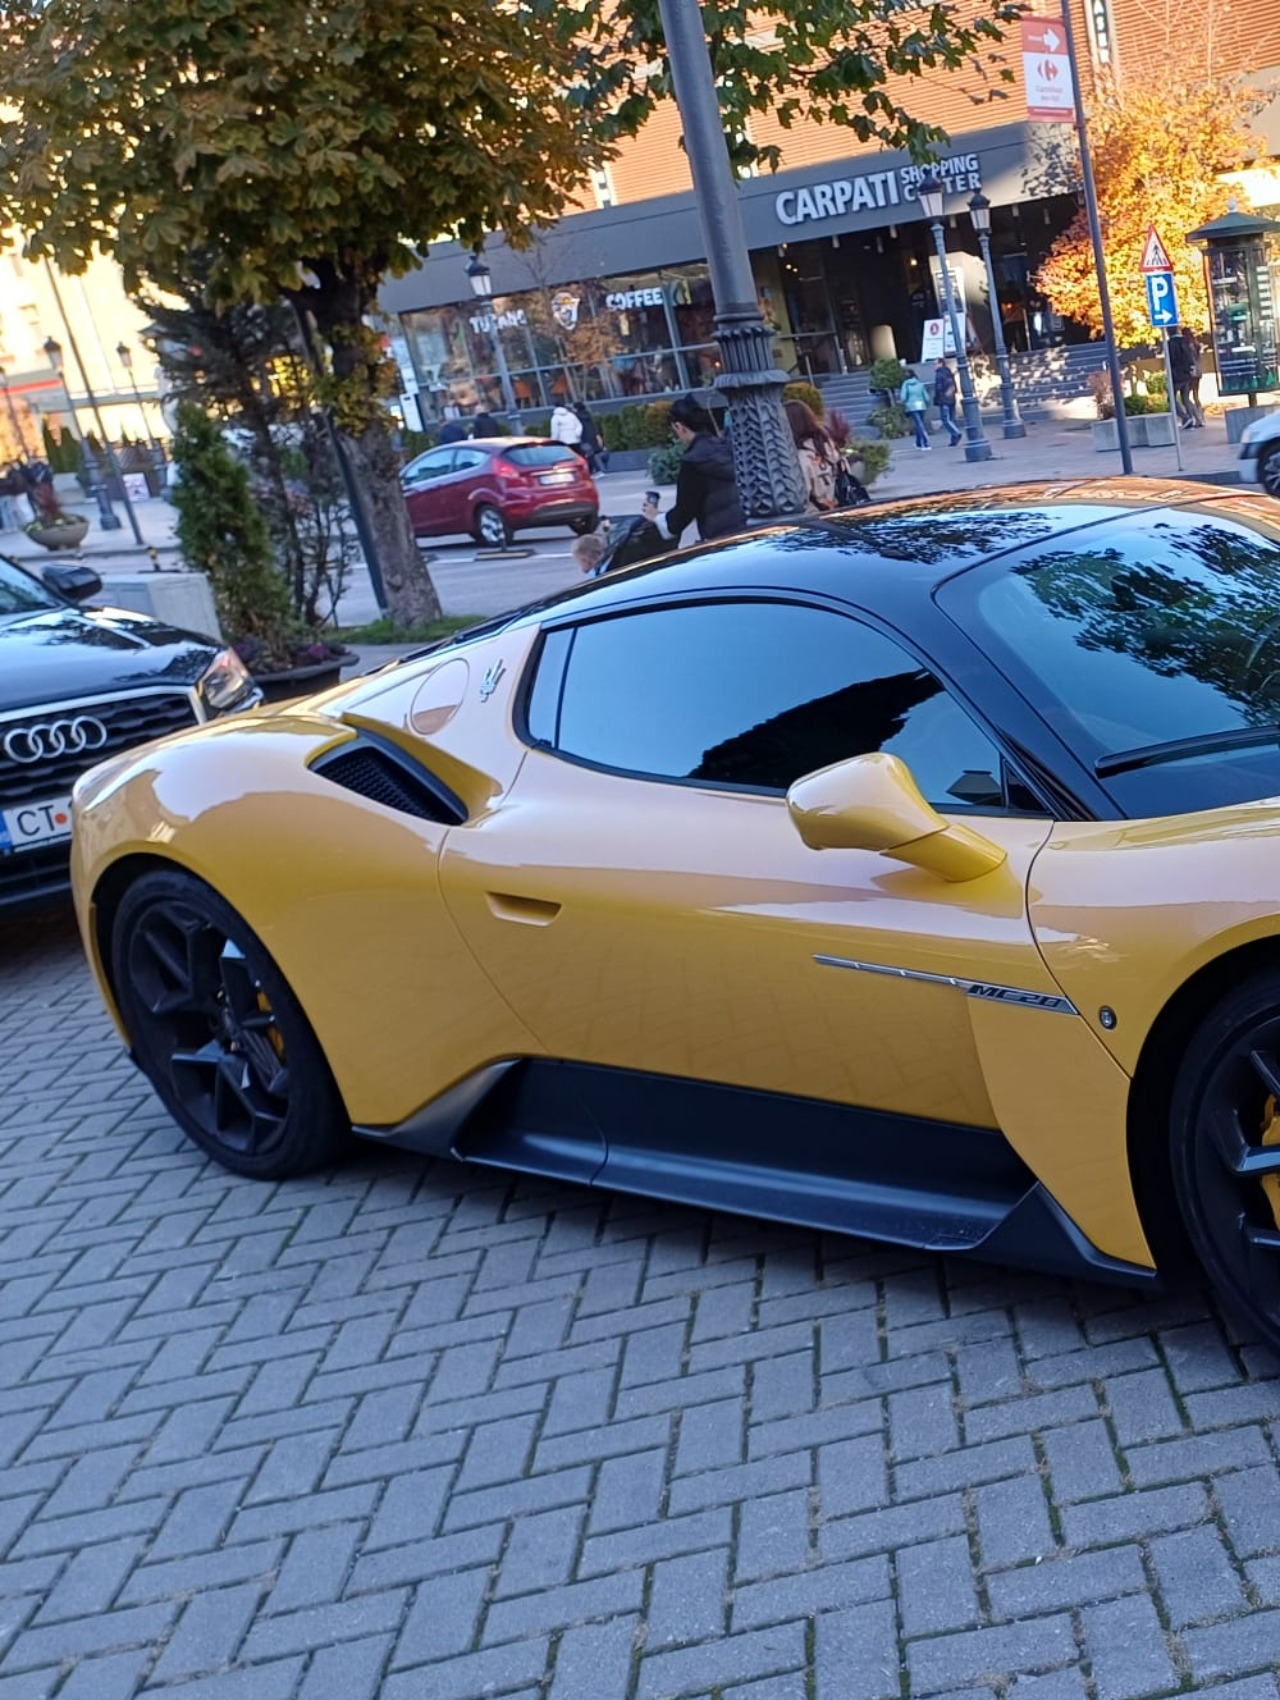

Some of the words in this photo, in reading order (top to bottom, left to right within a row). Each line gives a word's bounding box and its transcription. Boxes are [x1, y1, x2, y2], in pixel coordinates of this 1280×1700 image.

[775, 170, 899, 225] CARPATI
[904, 172, 981, 202] CTER
[605, 287, 664, 311] COFFEE
[1151, 276, 1169, 311] P
[17, 804, 55, 837] CT
[968, 984, 1063, 1008] MC20
